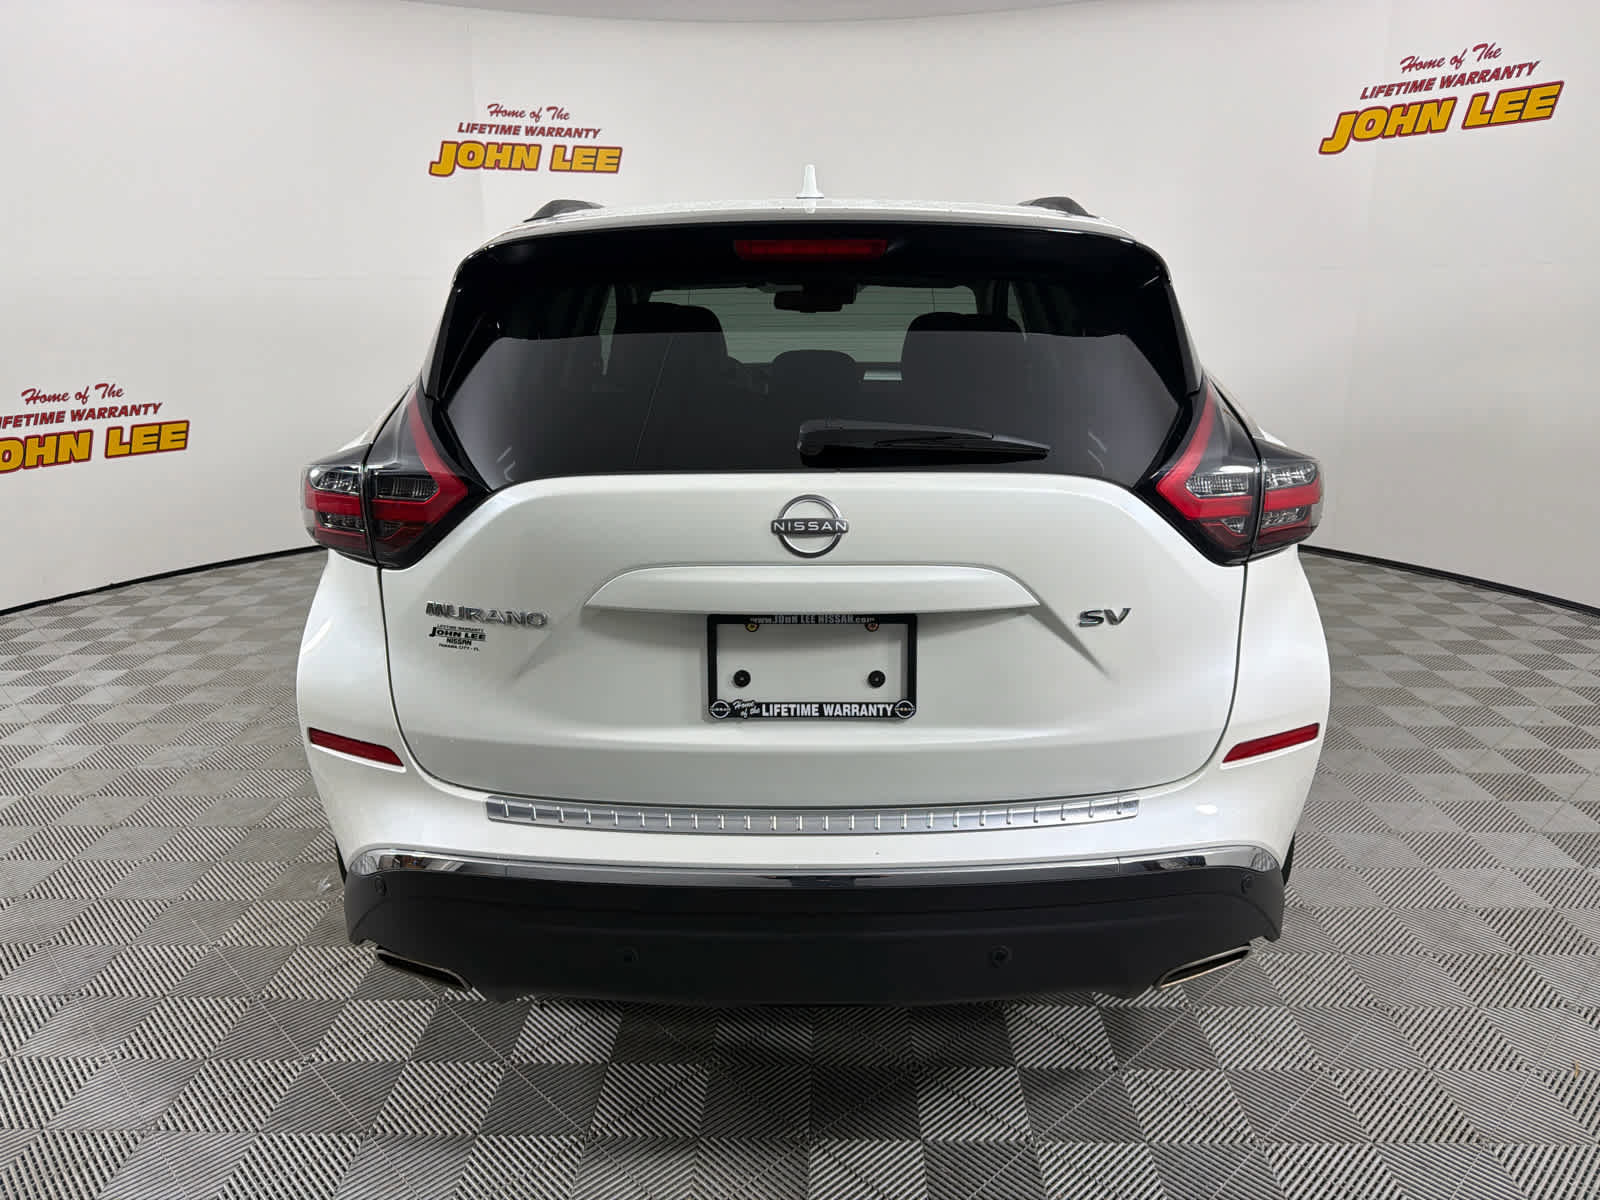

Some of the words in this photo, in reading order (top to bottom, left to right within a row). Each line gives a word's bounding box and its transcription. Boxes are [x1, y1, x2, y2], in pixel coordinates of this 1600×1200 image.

[1400, 56, 1446, 74] Home
[1450, 49, 1468, 69] of
[1472, 42, 1502, 62] The
[1360, 77, 1436, 100] LIFETIME
[1439, 60, 1540, 89] WARRANTY
[487, 103, 526, 118] Home
[529, 111, 542, 122] of
[546, 106, 570, 120] The
[1318, 96, 1458, 155] JOHN
[1461, 80, 1564, 130] LEE
[457, 122, 521, 136] LIFETIME
[524, 126, 601, 139] WARRANTY
[428, 140, 542, 177] JOHN
[549, 144, 623, 174] LEE
[21, 387, 70, 405] Home
[74, 386, 90, 405] of
[95, 383, 124, 399] The
[0, 411, 66, 429] FETIME
[70, 402, 163, 422] WARRANTY
[0, 429, 93, 474] OHN
[104, 420, 190, 459] LEE
[773, 520, 847, 532] NISSAN
[425, 601, 548, 629] MURANO
[800, 615, 816, 624] LEE
[1079, 607, 1131, 627] SV
[429, 626, 461, 638] JOHN
[464, 632, 487, 641] LEE
[446, 637, 472, 646] NISSAN
[732, 701, 754, 710] Home
[762, 703, 820, 717] LIFETIME
[823, 703, 894, 717] WARRANTY
